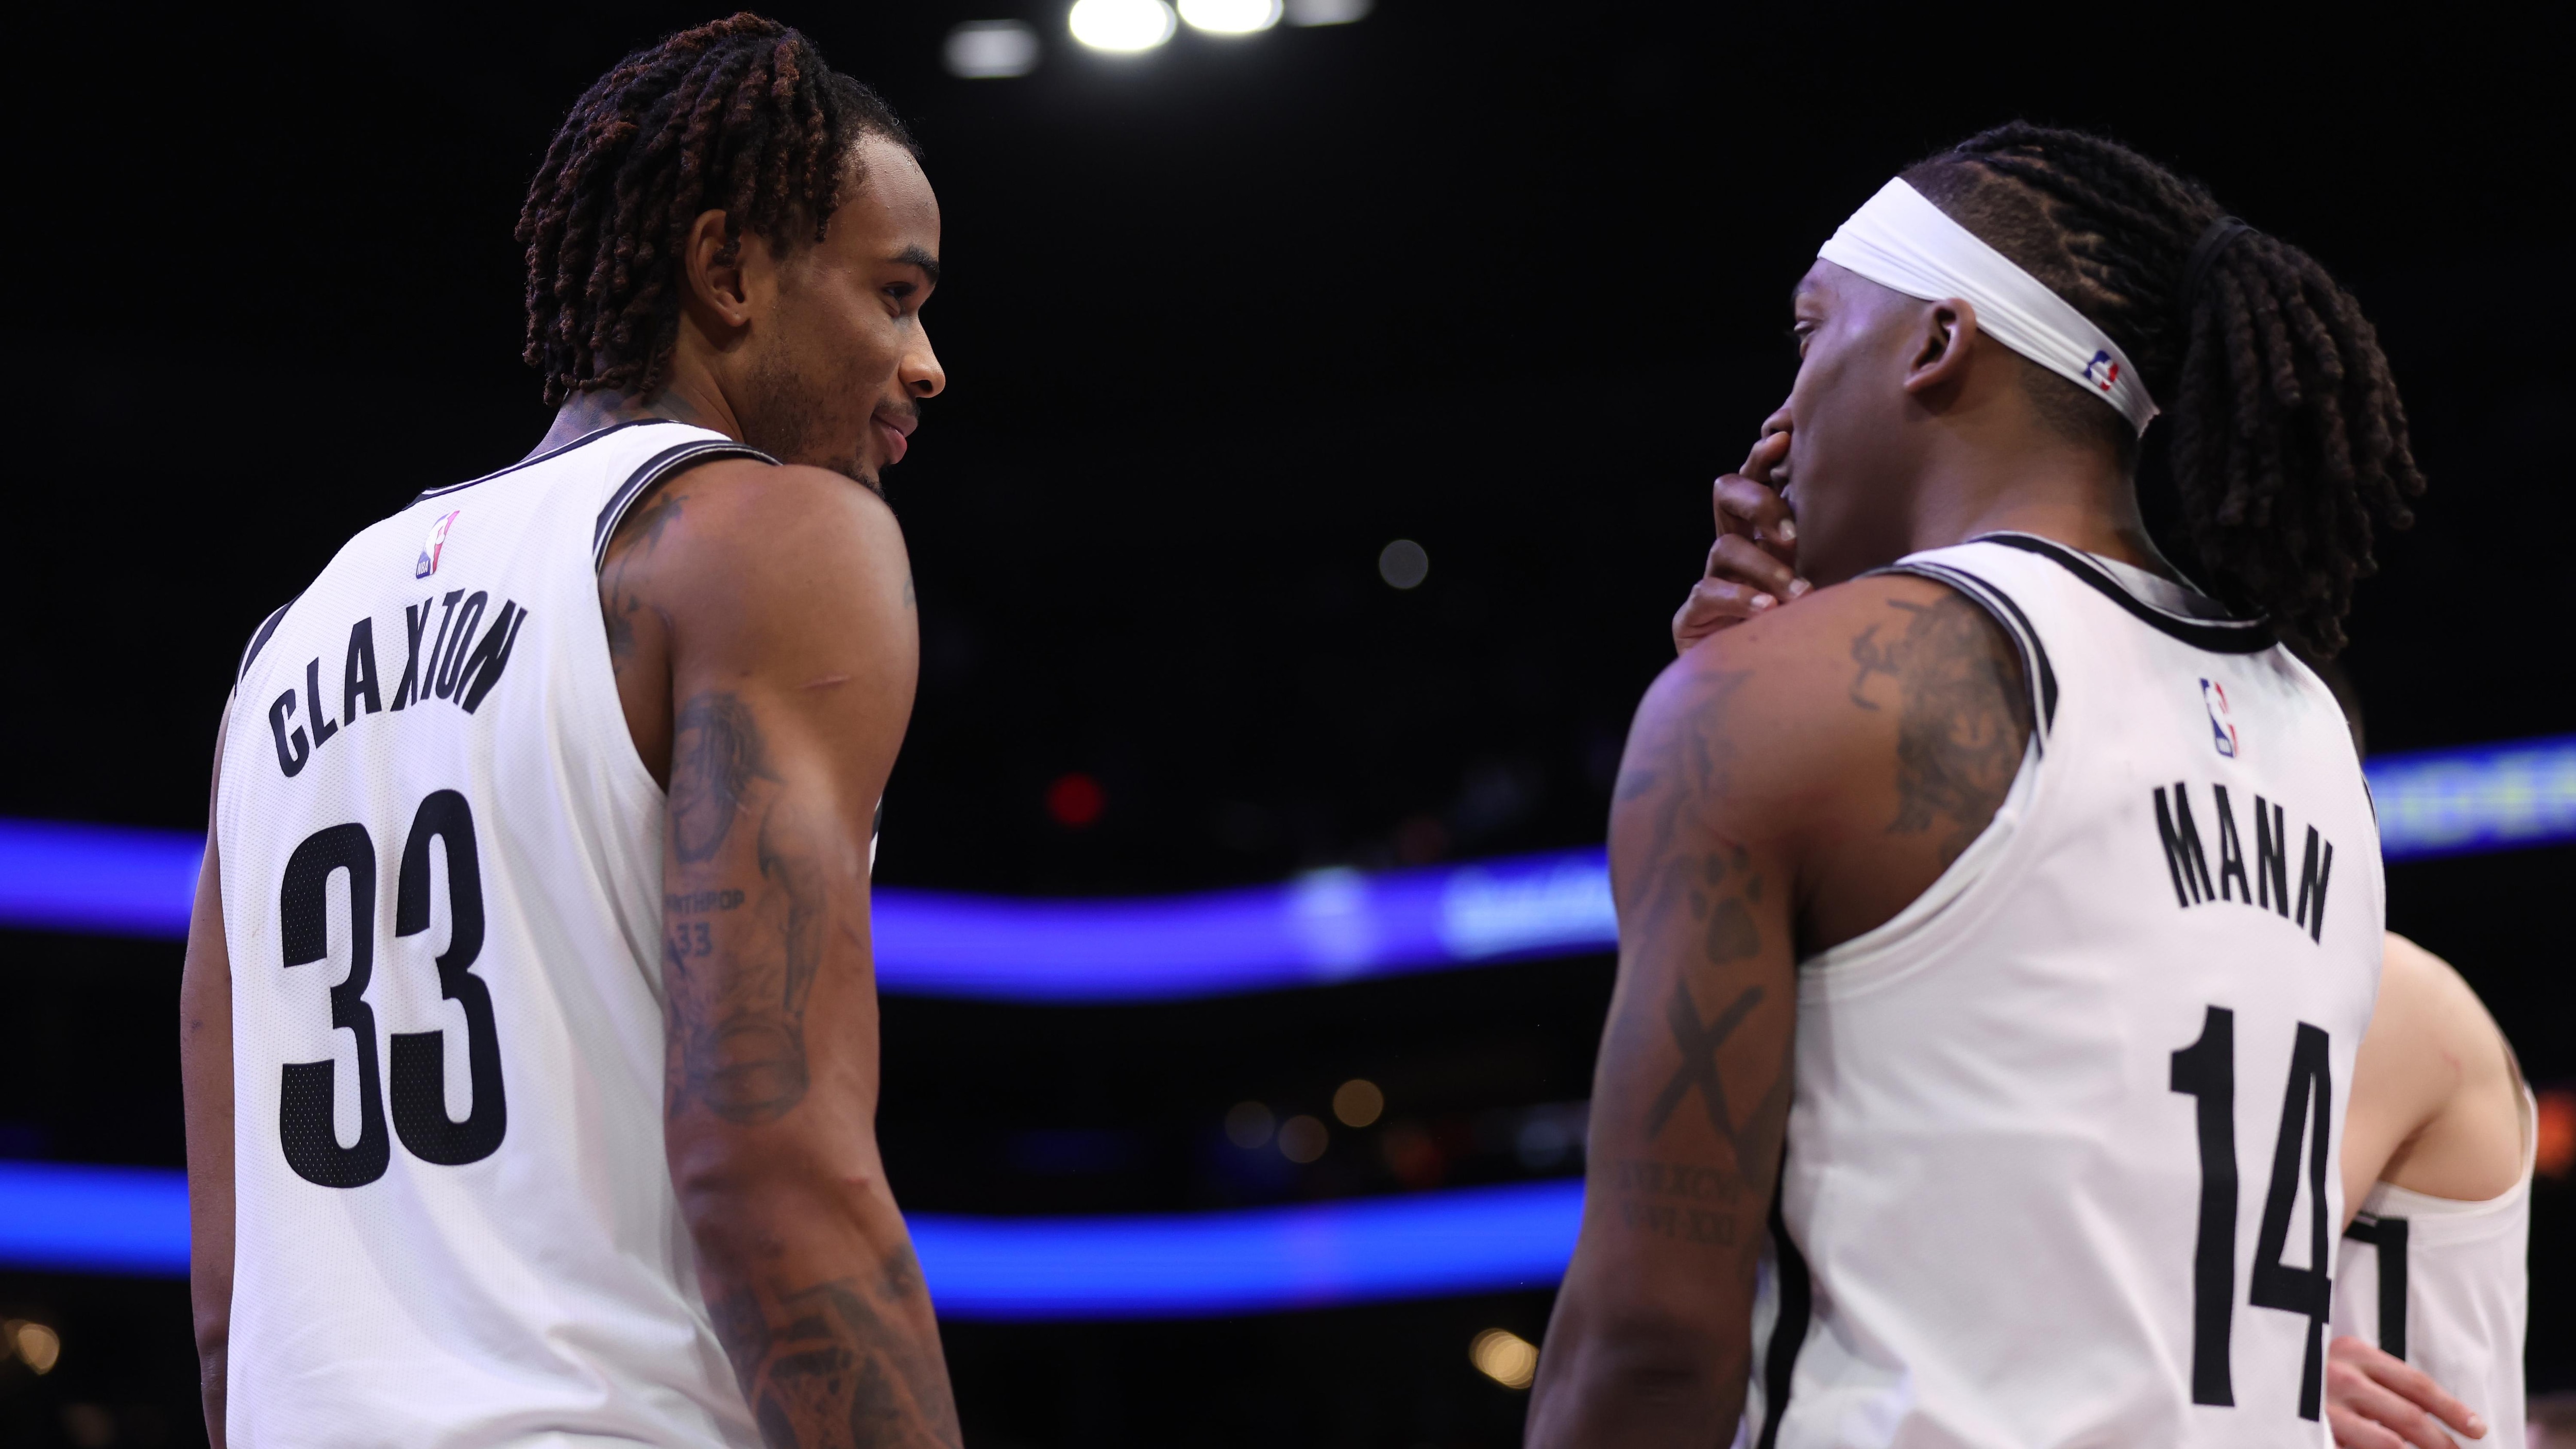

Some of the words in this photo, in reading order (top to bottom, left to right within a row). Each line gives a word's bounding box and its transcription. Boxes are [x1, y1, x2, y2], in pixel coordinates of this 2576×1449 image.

[416, 560, 429, 576] NBA
[268, 588, 528, 778] CLAXTON
[2153, 782, 2333, 945] MANN
[280, 789, 507, 1188] 33
[2170, 1004, 2332, 1422] 14
